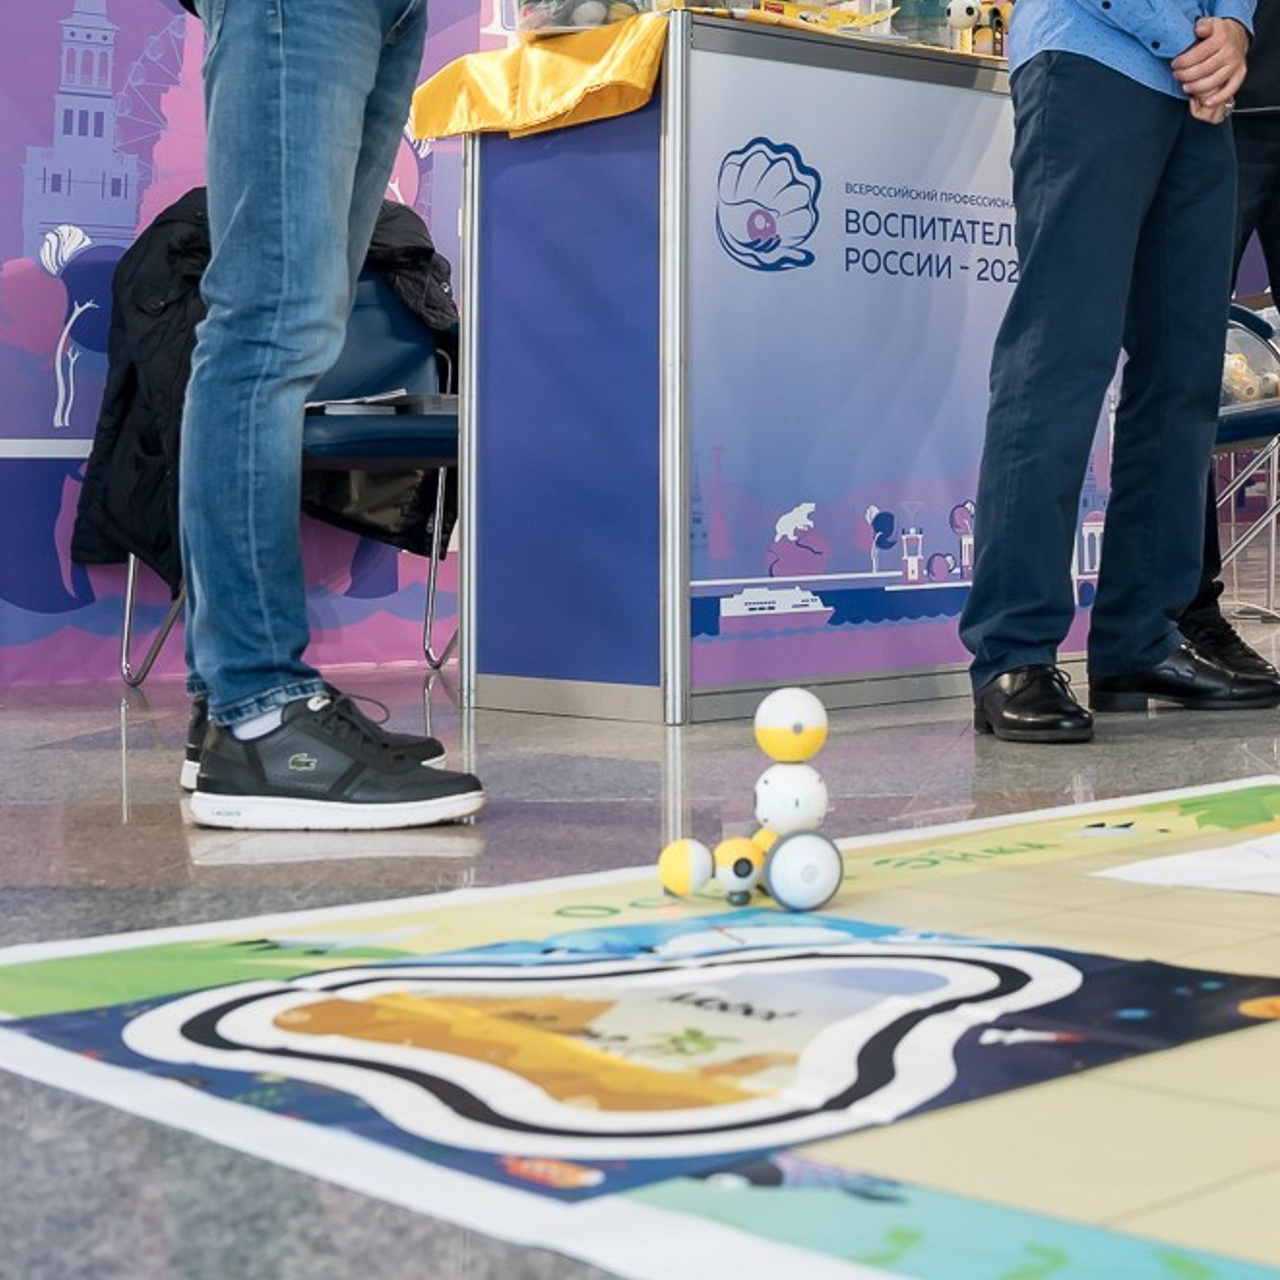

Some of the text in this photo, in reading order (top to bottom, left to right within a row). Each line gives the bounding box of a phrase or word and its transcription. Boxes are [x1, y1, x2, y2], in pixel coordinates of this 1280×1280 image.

[845, 182, 938, 202] ВСЕРОССИЙСКИЙ
[845, 208, 1017, 247] ВОСПИТАТЕЛ
[845, 247, 952, 280] РОССИИ
